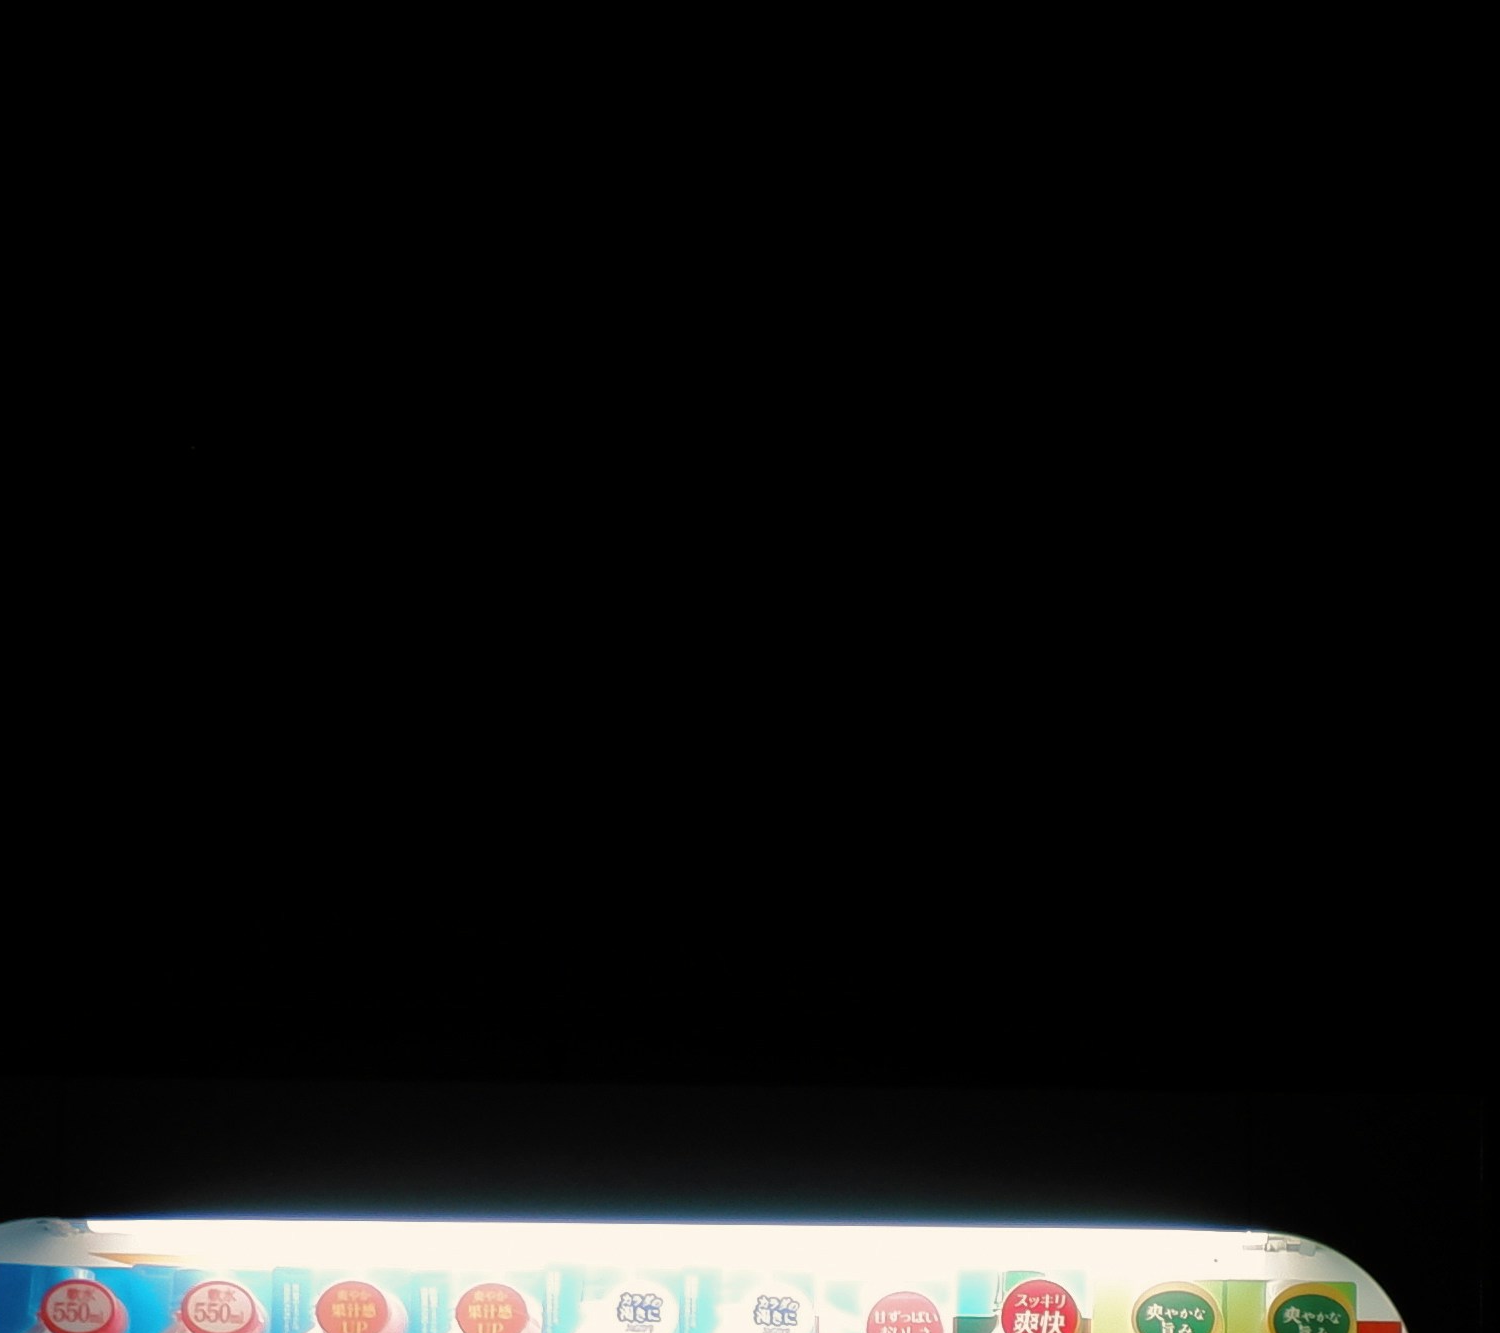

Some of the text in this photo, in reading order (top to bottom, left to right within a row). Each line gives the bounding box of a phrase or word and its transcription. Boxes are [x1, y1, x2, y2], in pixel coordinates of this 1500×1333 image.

[1014, 1294, 1066, 1307] スッキリ
[193, 1302, 244, 1323] 550ml
[332, 1303, 376, 1318] 果汁感
[468, 1304, 513, 1320] 果汁感
[874, 1310, 938, 1325] 甘ずっぱい
[1145, 1303, 1205, 1320] 爽やかな
[1282, 1305, 1342, 1325] 爽やかな
